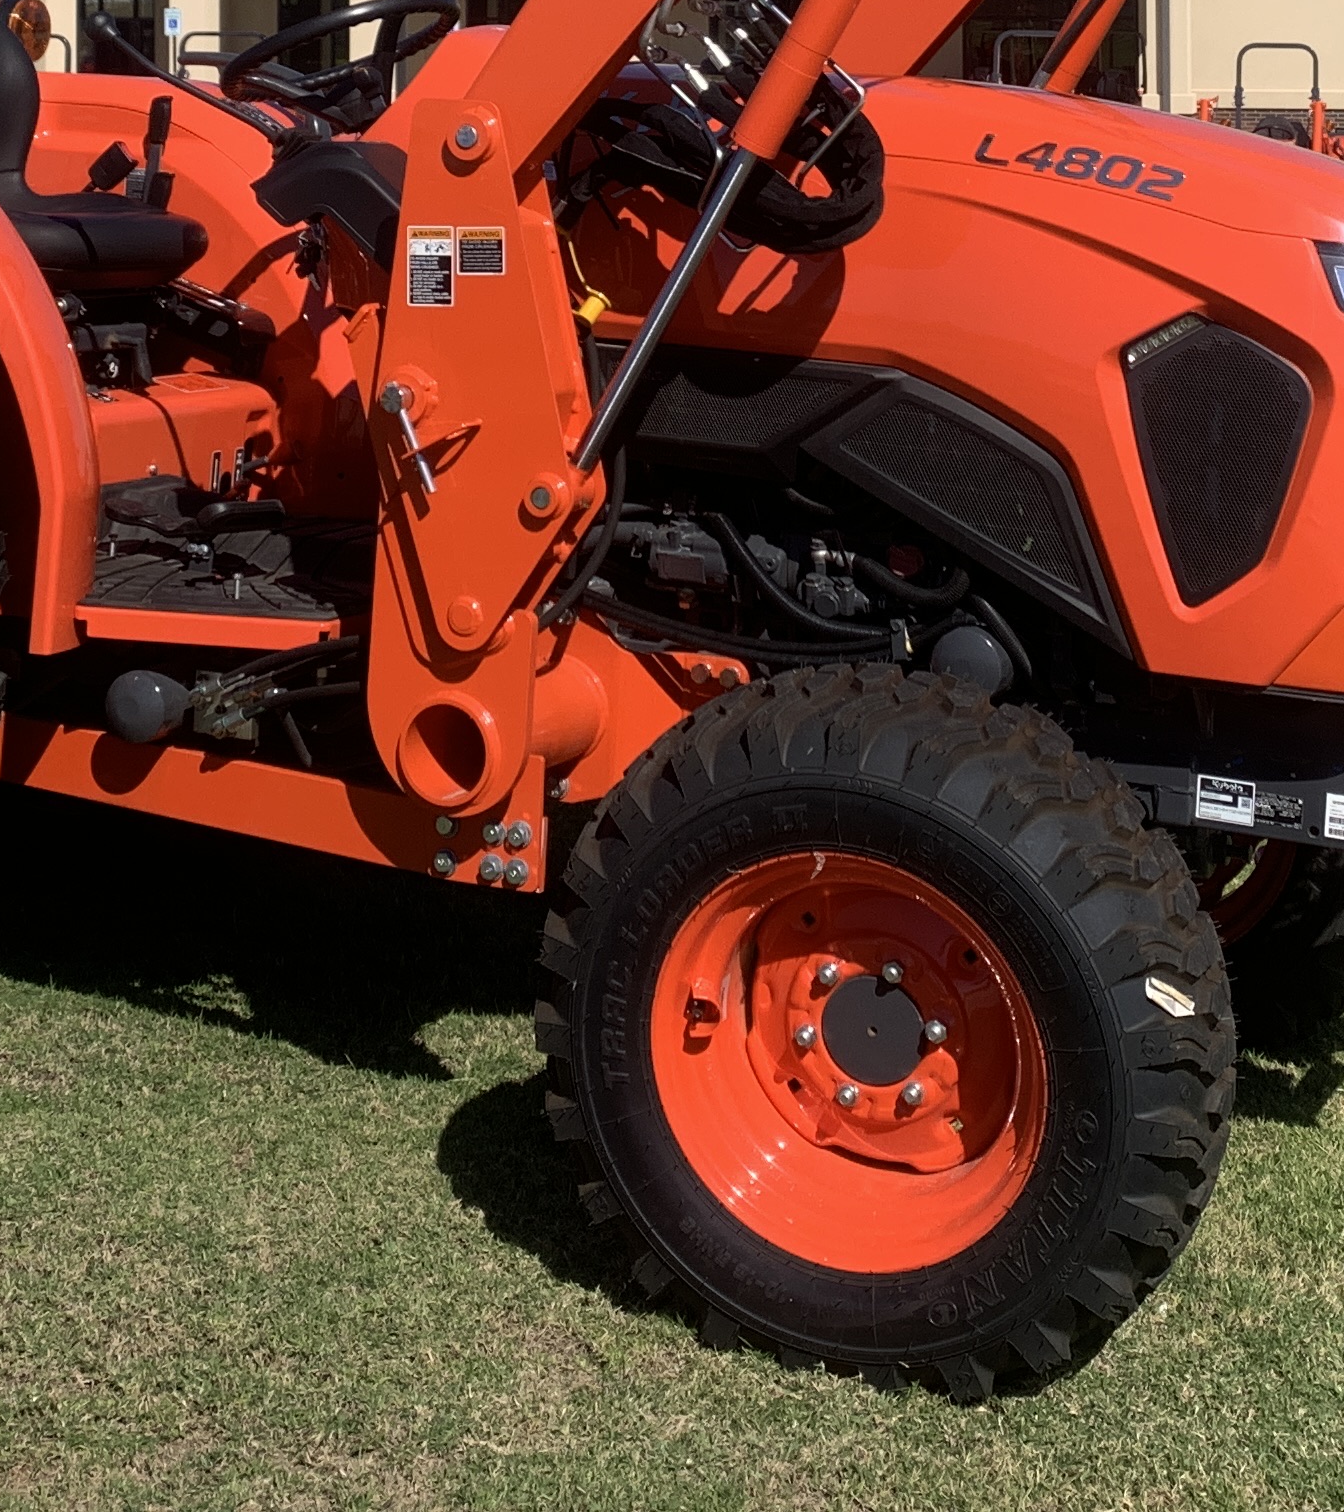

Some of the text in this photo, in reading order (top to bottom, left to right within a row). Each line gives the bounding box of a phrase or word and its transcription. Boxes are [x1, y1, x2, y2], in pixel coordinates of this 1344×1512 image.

[974, 134, 1186, 202] L4802
[1212, 779, 1244, 792] Kubota
[599, 958, 639, 1091] TRAC
[620, 812, 755, 952] LOADER
[961, 1144, 1097, 1320] TITAN
